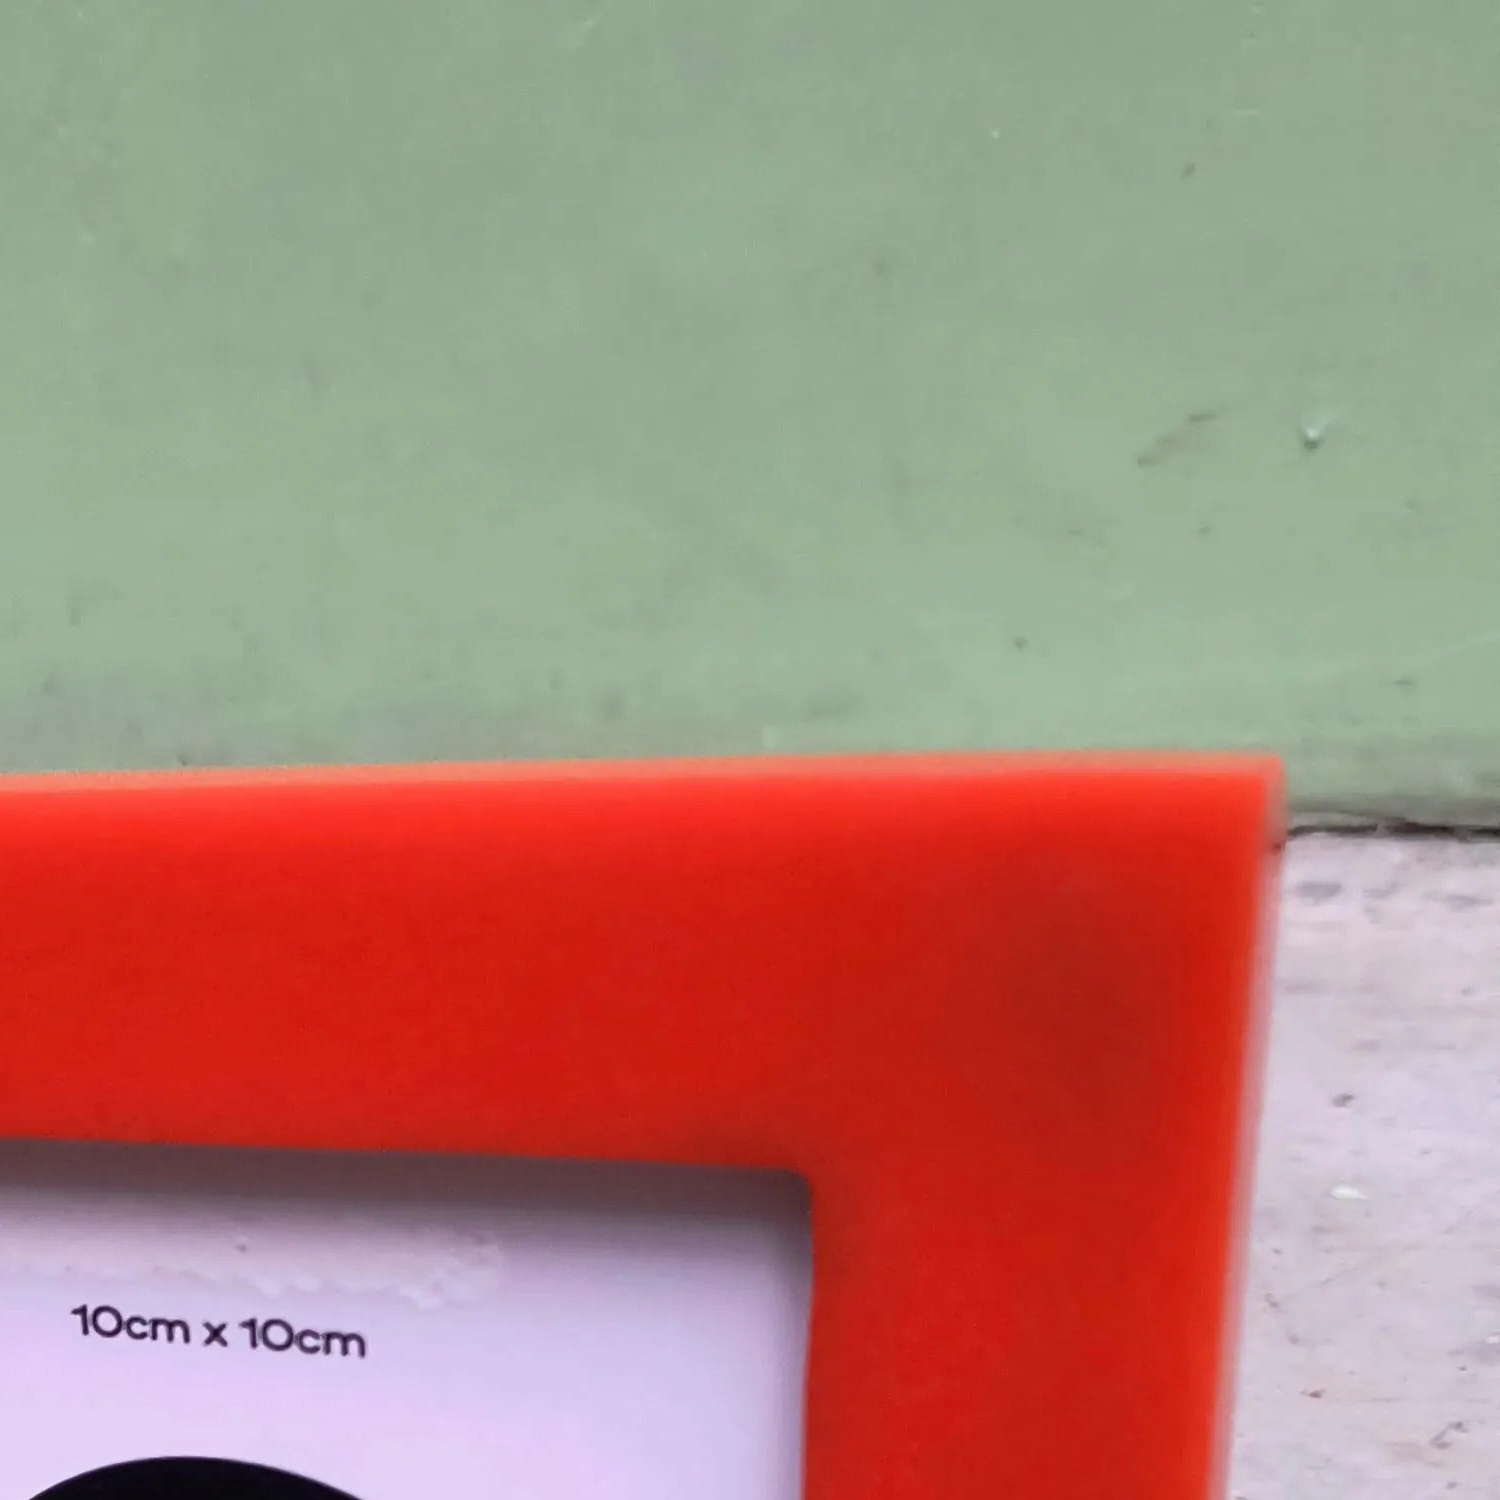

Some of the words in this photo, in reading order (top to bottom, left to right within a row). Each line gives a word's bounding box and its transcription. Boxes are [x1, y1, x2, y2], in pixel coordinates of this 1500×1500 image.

[71, 1304, 191, 1344] 10cm
[203, 1321, 228, 1347] x
[238, 1317, 366, 1358] 10cm
